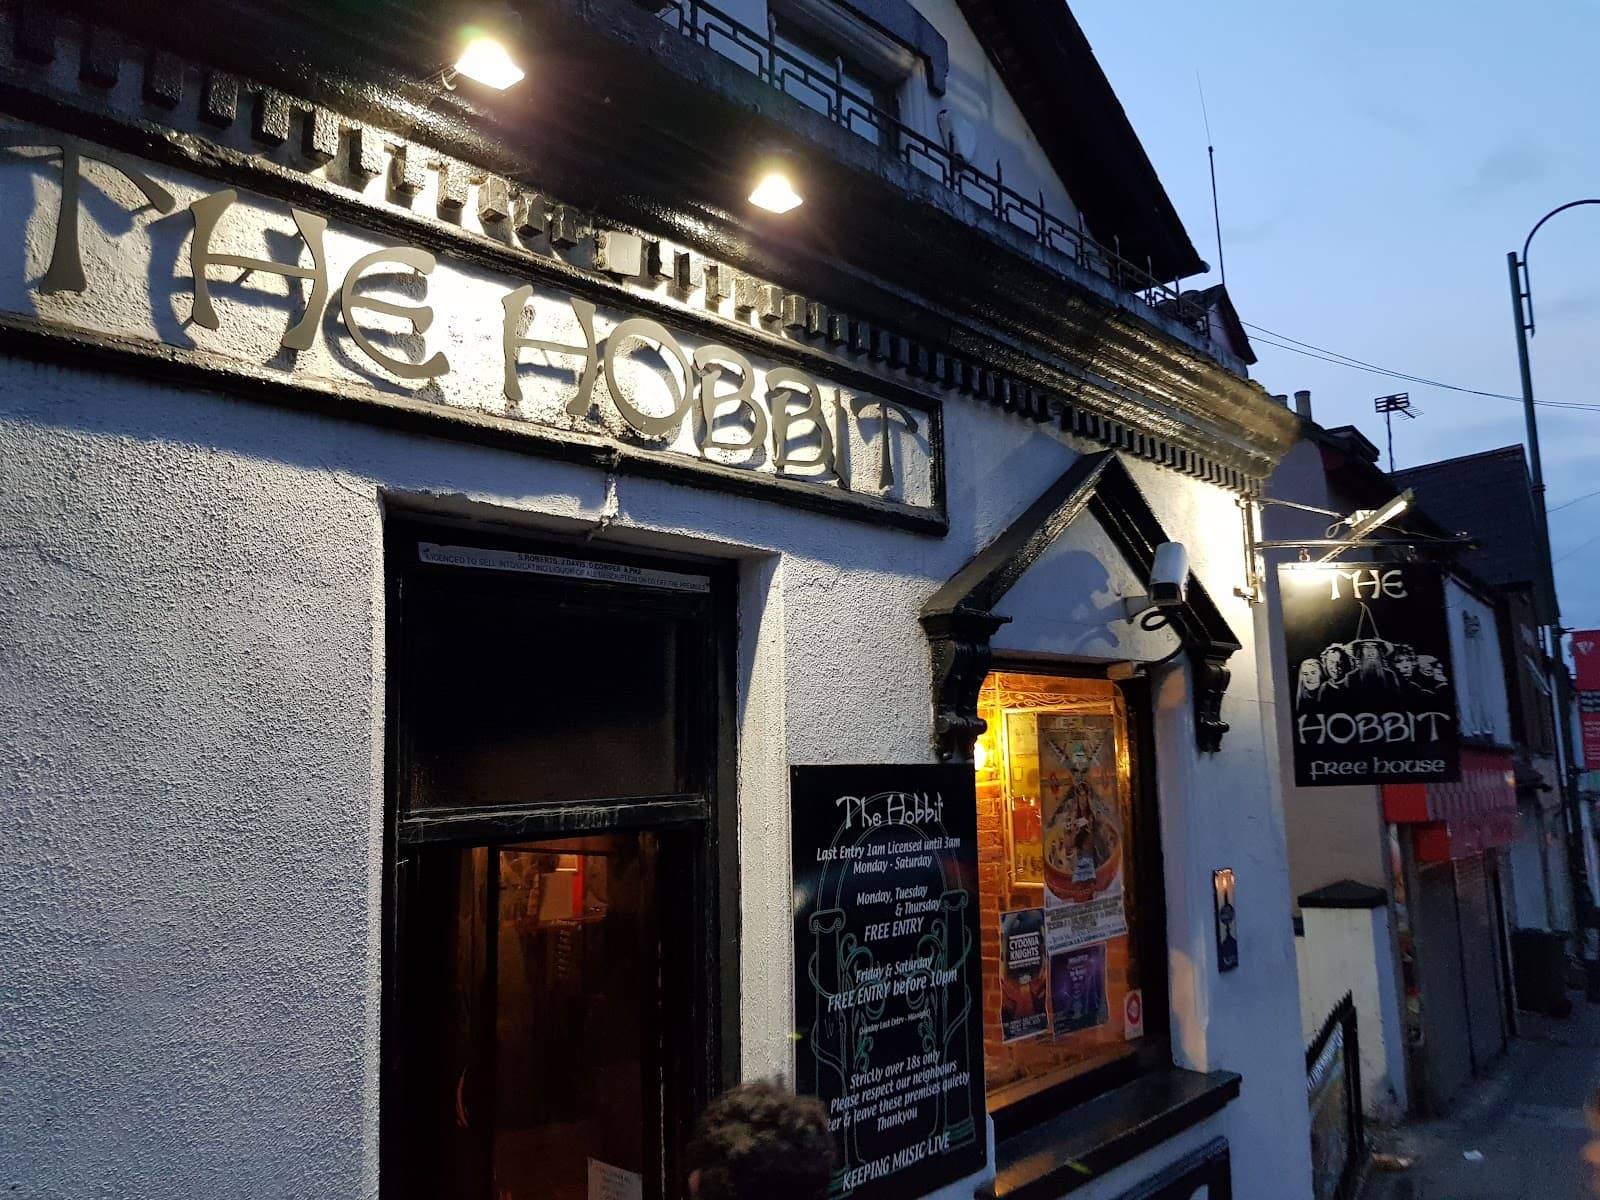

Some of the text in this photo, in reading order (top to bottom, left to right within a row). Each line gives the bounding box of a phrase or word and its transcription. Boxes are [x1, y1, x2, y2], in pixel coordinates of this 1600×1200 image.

[2, 143, 919, 490] THE HOBBIT
[1331, 569, 1408, 600] THE
[1297, 711, 1450, 744] HOBBIT
[1373, 757, 1446, 774] house
[836, 792, 943, 829] The Hobbit
[817, 836, 961, 862] Last Entry 1am Licensed until 3am
[853, 859, 888, 875] Monday
[895, 855, 932, 870] Saturday
[856, 885, 928, 906] Monday, Tuesday
[895, 898, 941, 917] & Thursday
[864, 916, 924, 942] FREE ENTRY
[1010, 946, 1039, 961] KNIGHTS
[856, 957, 932, 983] Friday & Saturday
[828, 968, 957, 1012] FREE ENTRY before 10pm
[850, 1050, 940, 1090] Strictly over 18s only
[830, 1060, 957, 1114] Please respect our neighbours
[844, 1113, 852, 1128] &
[853, 1104, 877, 1124] leave
[879, 1093, 903, 1113] these
[904, 1081, 941, 1104] premises
[942, 1071, 970, 1092] quietly
[877, 1106, 918, 1132] Thankyou
[842, 1132, 950, 1192] KEEPING MUSIC LIVE
